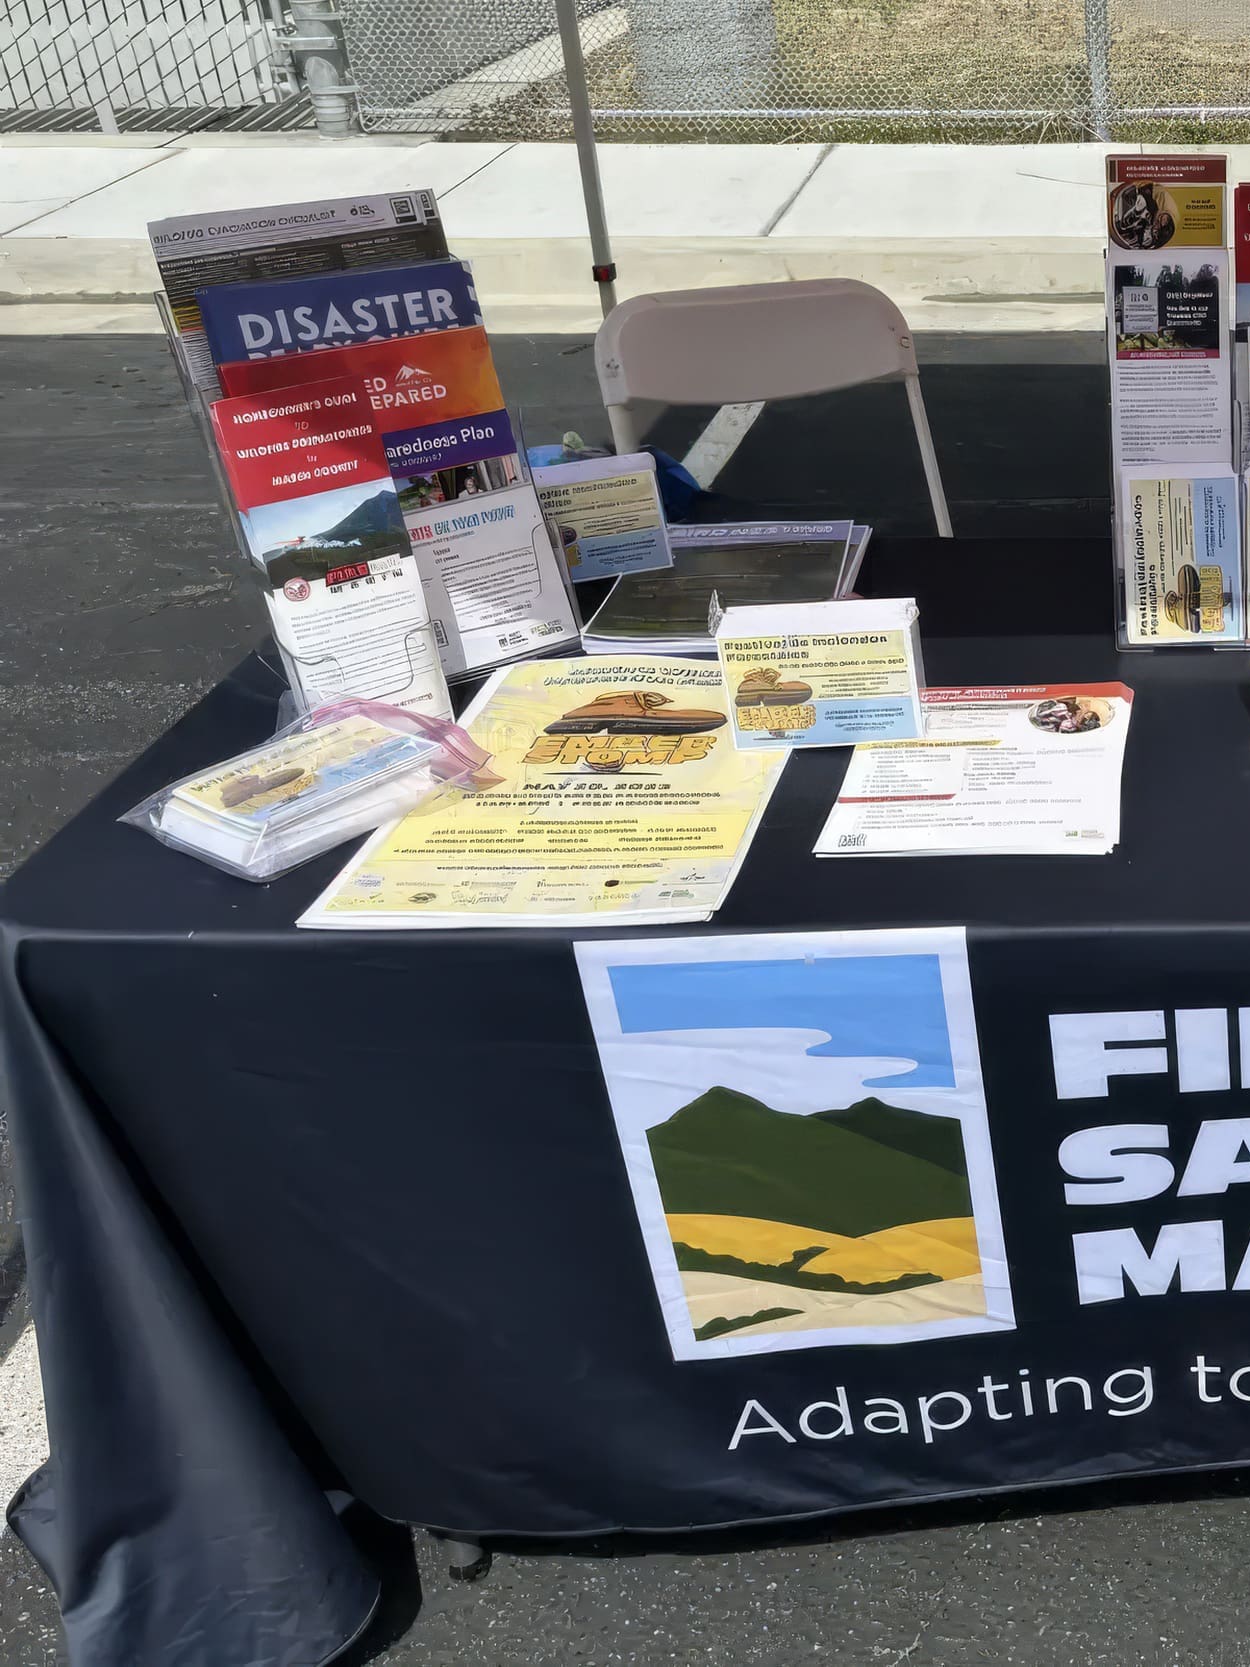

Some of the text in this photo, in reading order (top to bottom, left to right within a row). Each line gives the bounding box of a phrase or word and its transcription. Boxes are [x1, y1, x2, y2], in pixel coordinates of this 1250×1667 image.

[238, 288, 458, 348] DISASTER
[369, 384, 447, 410] EPARED
[460, 426, 495, 442] Plan
[727, 1365, 1154, 1450] Adapting
